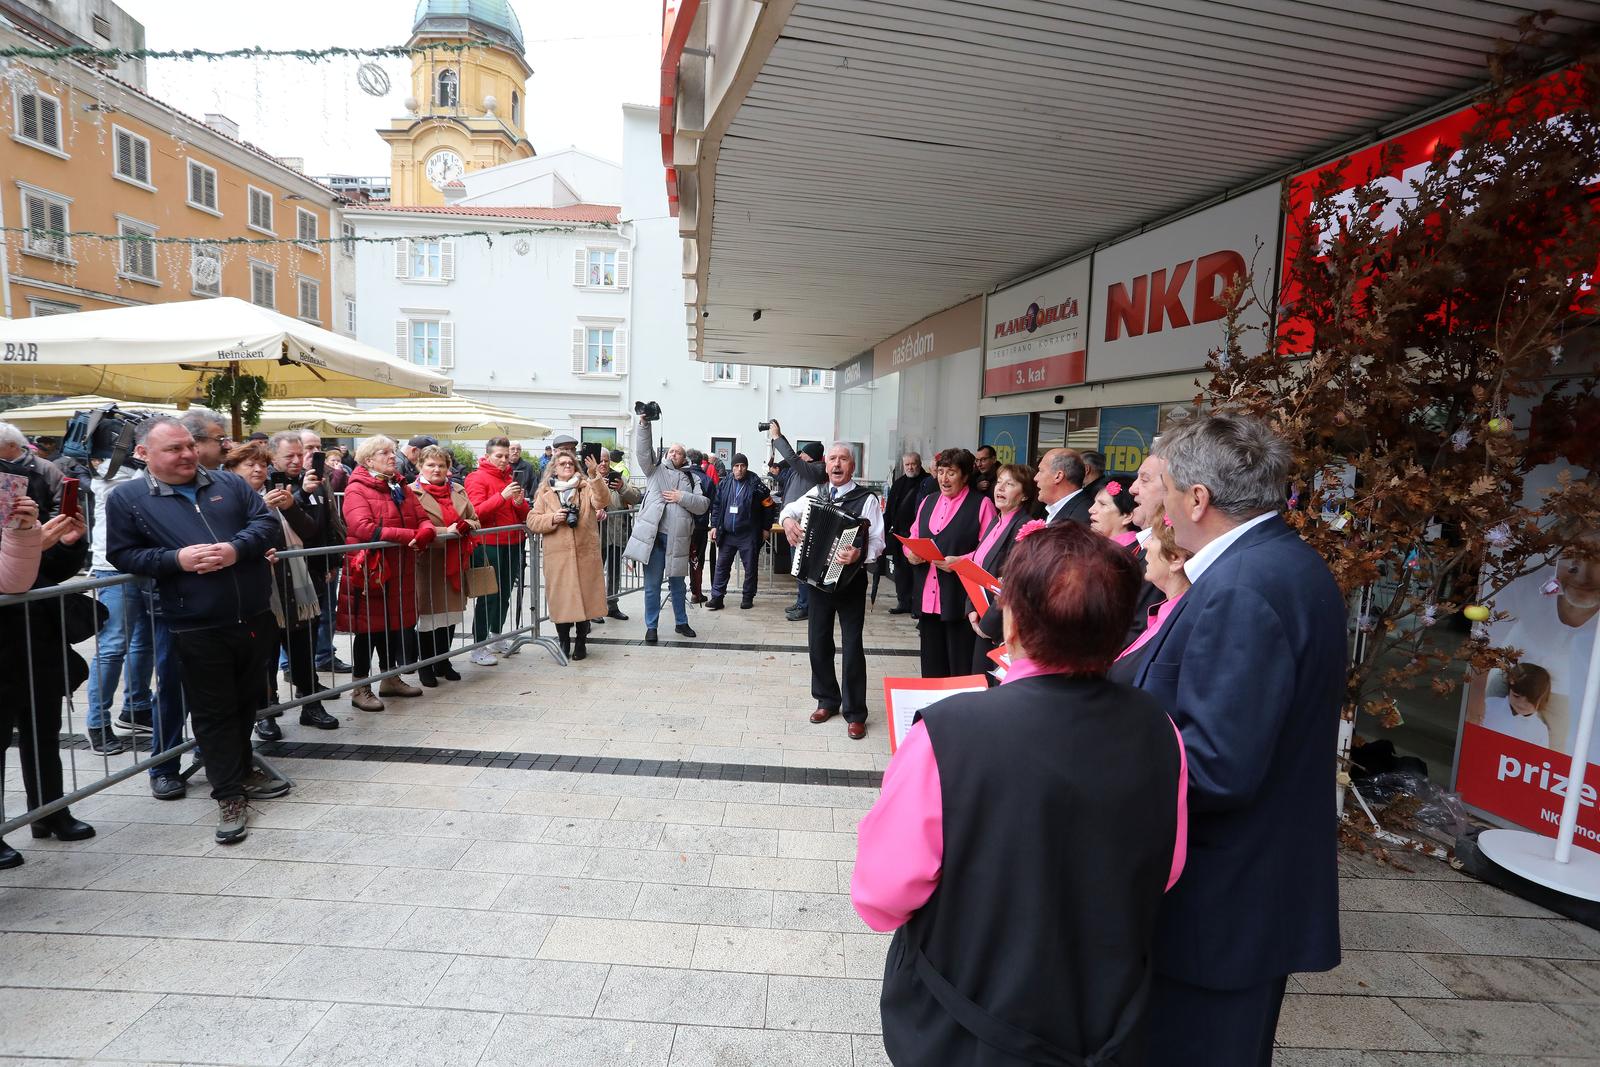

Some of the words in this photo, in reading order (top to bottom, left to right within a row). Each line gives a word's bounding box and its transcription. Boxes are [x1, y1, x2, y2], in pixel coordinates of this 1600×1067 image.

[1104, 250, 1247, 343] NKD
[4, 342, 38, 362] BAR
[913, 331, 934, 358] dom
[217, 350, 264, 360] Heineken
[1016, 372, 1026, 385] 3.
[1028, 365, 1046, 383] kat
[1497, 753, 1600, 810] prize
[1540, 807, 1561, 826] NK
